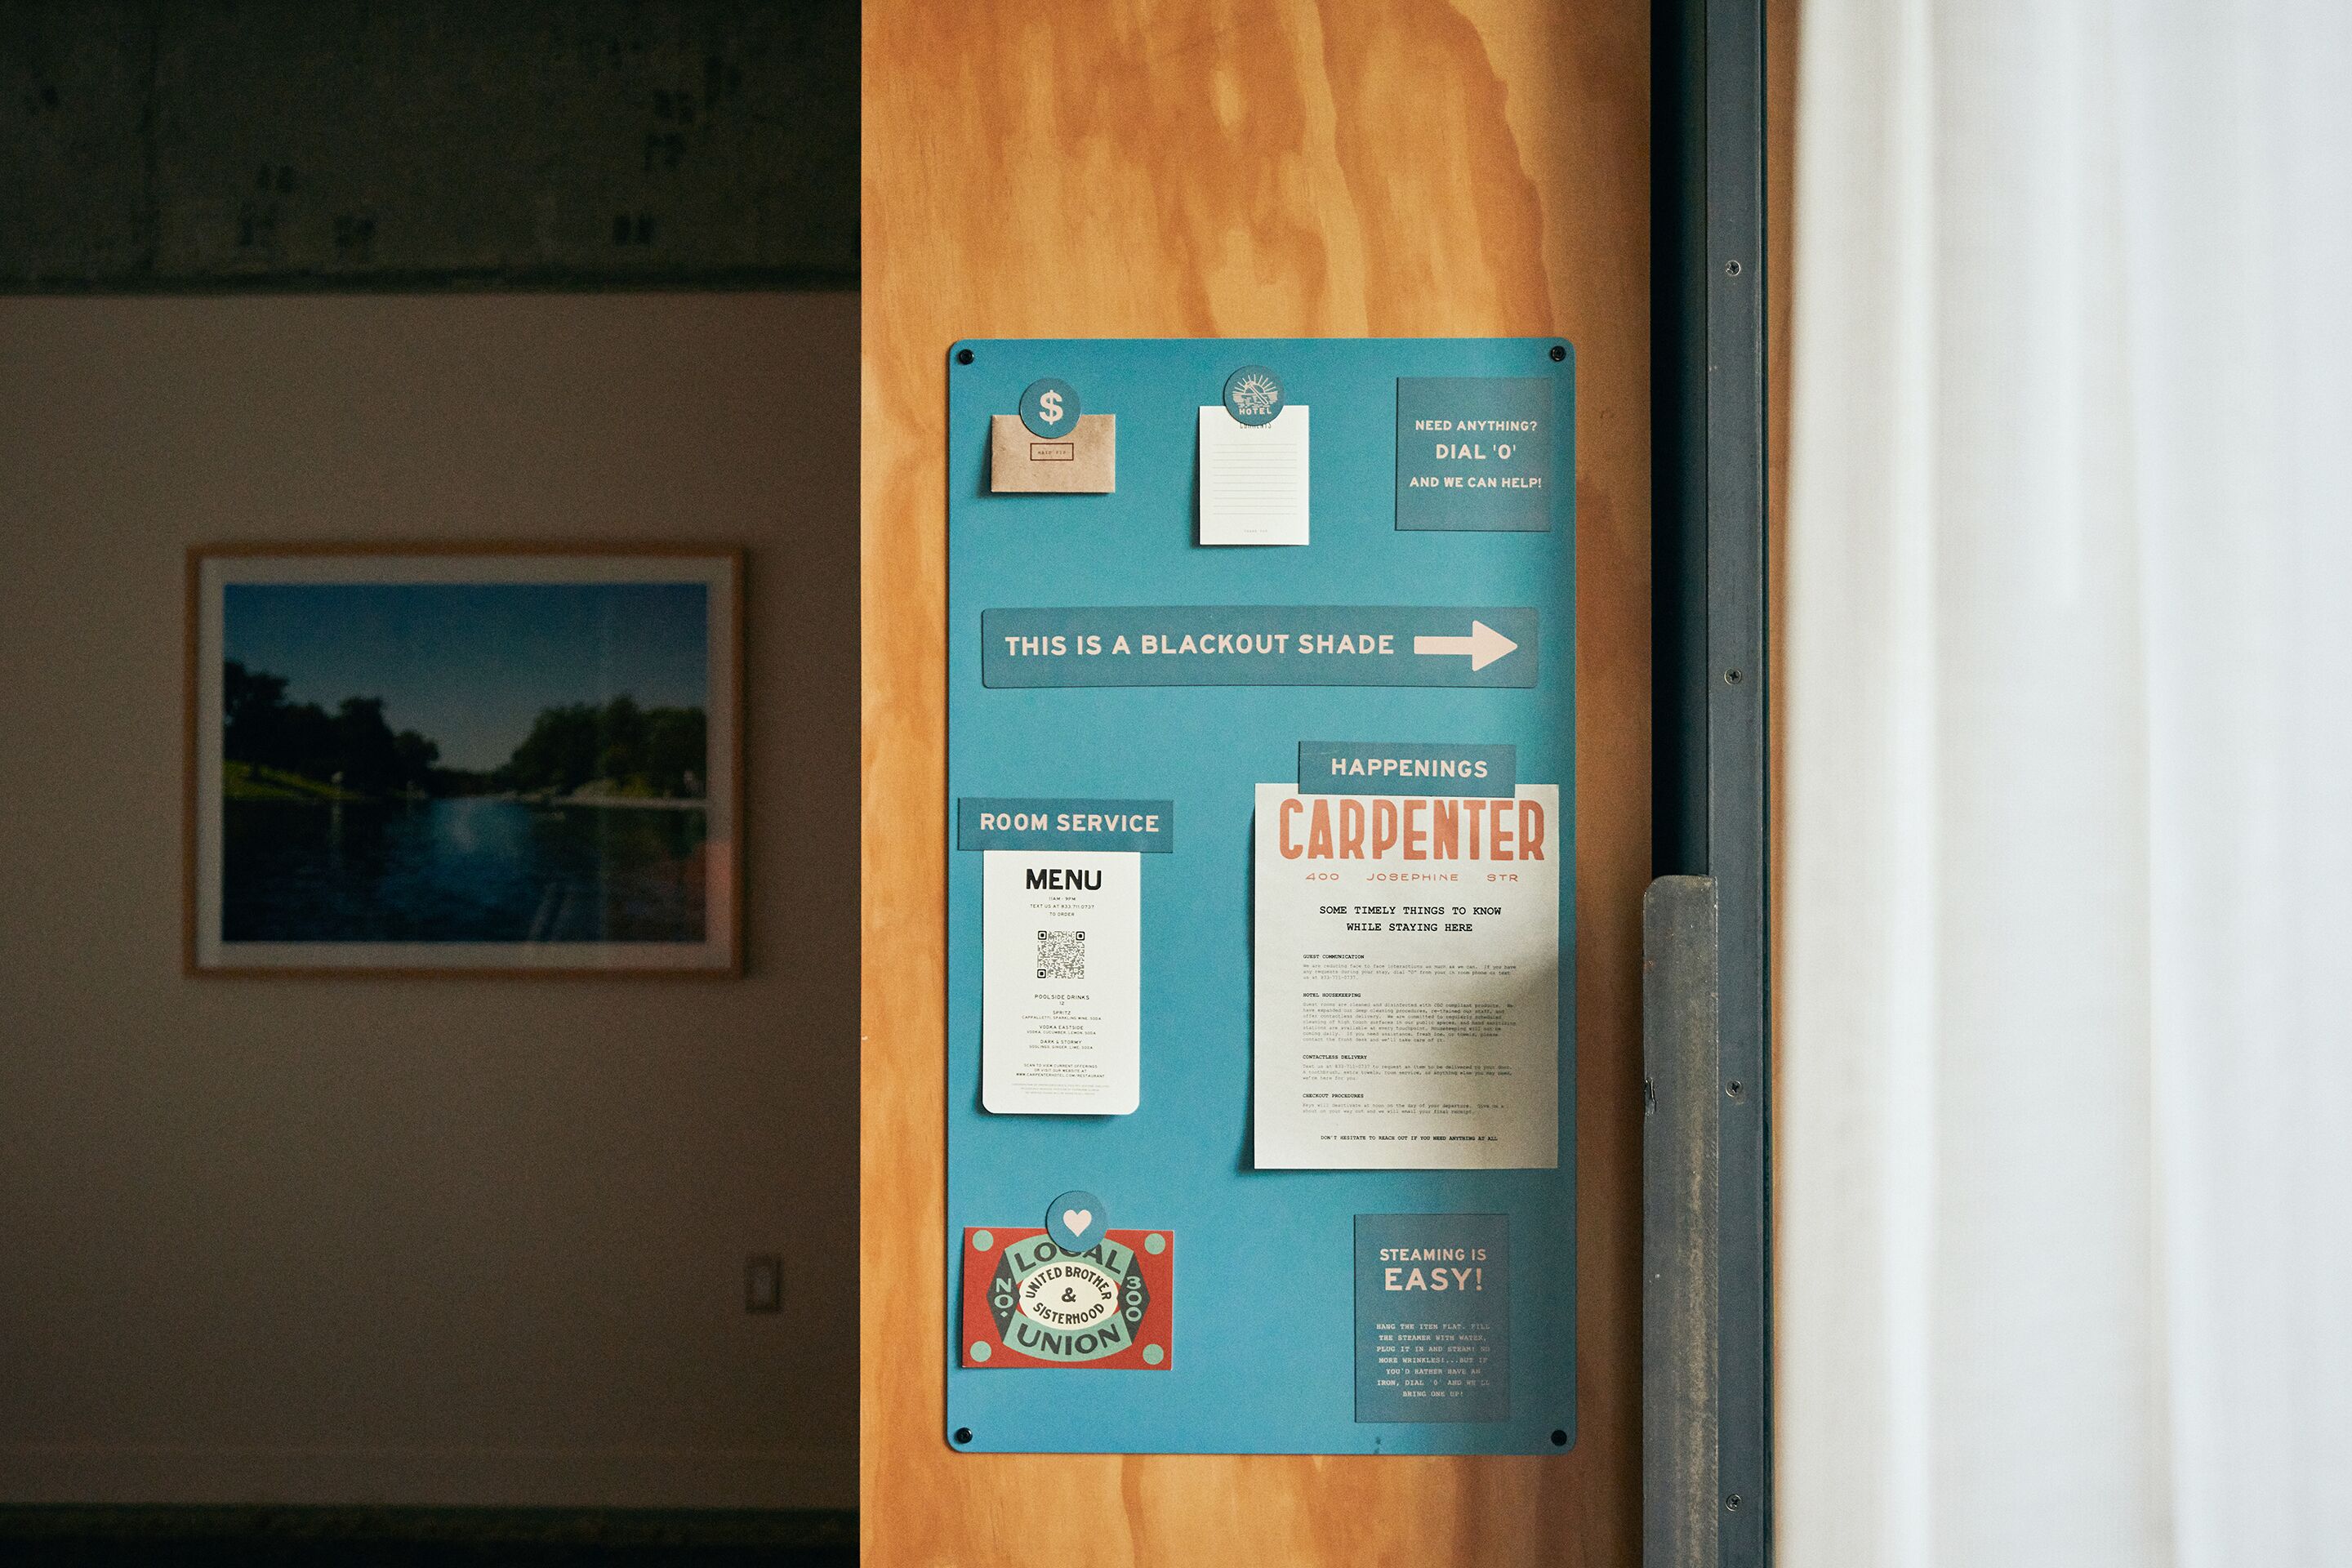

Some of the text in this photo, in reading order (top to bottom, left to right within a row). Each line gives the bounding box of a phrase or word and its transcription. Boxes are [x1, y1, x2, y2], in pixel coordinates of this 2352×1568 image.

[1415, 420, 1537, 431] NEED ANYTHING?
[1436, 444, 1486, 459] DIAL
[1410, 477, 1541, 488] AND WE CAN HELP!
[1004, 634, 1394, 656] THIS IS A BLACKOUT SHADE
[1332, 759, 1488, 778] HAPPENINGS
[981, 813, 1159, 832] ROOM SERVICE
[1280, 798, 1544, 861] CARPENTER
[1026, 869, 1102, 890] MENU
[1305, 873, 1518, 882] 400 JOSEPHINE STR
[1319, 906, 1502, 915] SOME TIMELY THINGS TO KNOW
[1347, 923, 1472, 932] WHILE STAYING HERE
[1379, 1249, 1486, 1261] STEAMING IS
[1026, 1266, 1112, 1300] UNITED BROTHER
[1385, 1267, 1482, 1290] EASY!
[1062, 1287, 1076, 1303] &
[1125, 1276, 1143, 1322] 300
[1033, 1302, 1105, 1325] SISTERHOOD
[1017, 1323, 1120, 1356] UNION
